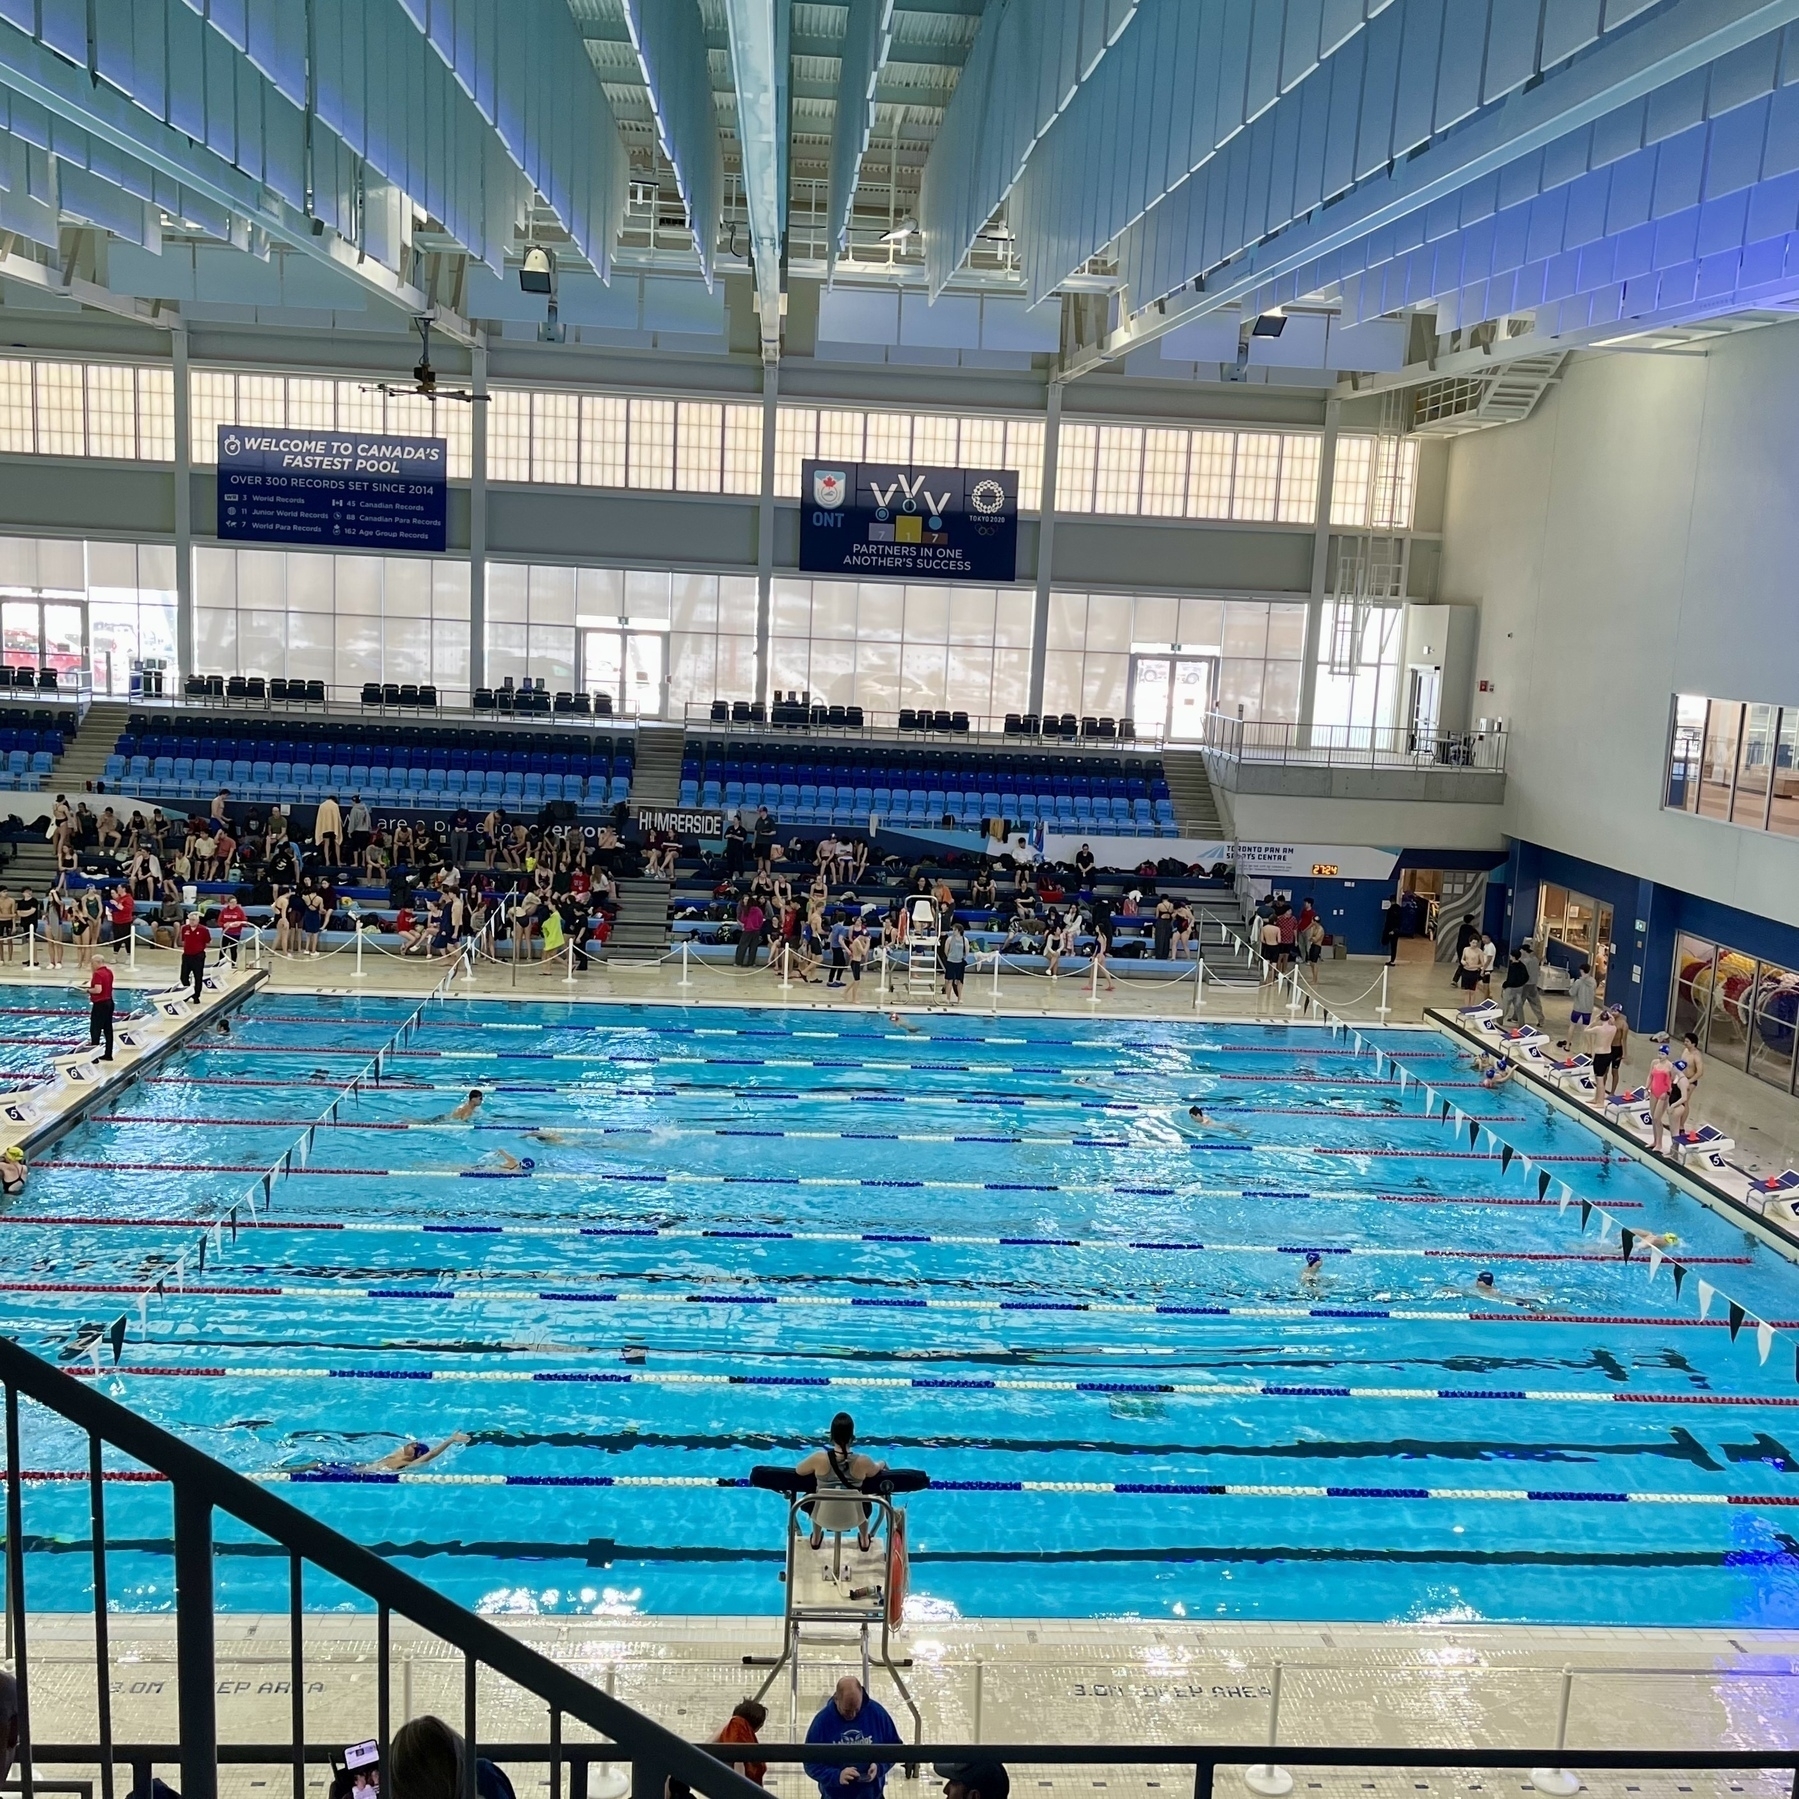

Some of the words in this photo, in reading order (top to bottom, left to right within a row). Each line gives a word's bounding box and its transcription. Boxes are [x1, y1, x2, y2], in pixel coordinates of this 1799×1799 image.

[244, 437, 327, 454] WELCOME
[331, 442, 353, 455] TO
[357, 444, 440, 461] CANADA'S
[282, 455, 353, 470] FASTEST
[355, 459, 400, 473] POOL
[230, 475, 262, 485] OVER
[265, 477, 287, 486] 300
[291, 478, 345, 490] RECORDS
[348, 481, 369, 491] SET
[372, 483, 405, 493] SINCE
[408, 485, 434, 495] 2014
[276, 496, 305, 504] Records
[359, 501, 393, 509] Canadian
[395, 503, 424, 511] Records
[252, 508, 274, 516] Junior
[300, 511, 329, 519] Records
[359, 514, 393, 523] Canadian
[412, 518, 441, 526] Records
[812, 511, 845, 528] ONT
[275, 523, 291, 531] Para
[375, 530, 398, 538] Group
[399, 531, 429, 539] Records
[878, 531, 886, 540] 7
[931, 533, 939, 543] 7
[853, 543, 917, 556] PARTNERS
[920, 547, 933, 557] IN
[936, 548, 963, 559] ONE
[843, 555, 913, 568] ANOTHER'S
[916, 559, 972, 571] SUCCESS
[639, 811, 722, 835] HUMBERSIDE
[1312, 865, 1338, 875] 27:24
[206, 980, 213, 988] 9
[167, 1006, 174, 1014] 8
[1486, 1021, 1492, 1029] 9
[123, 1035, 129, 1043] 7
[1531, 1048, 1538, 1056] 8
[70, 1069, 78, 1078] 6
[1584, 1079, 1590, 1087] 7
[10, 1109, 18, 1119] 5
[1643, 1114, 1650, 1124] 6
[1713, 1155, 1720, 1166] 5
[258, 1681, 324, 1694] ARA
